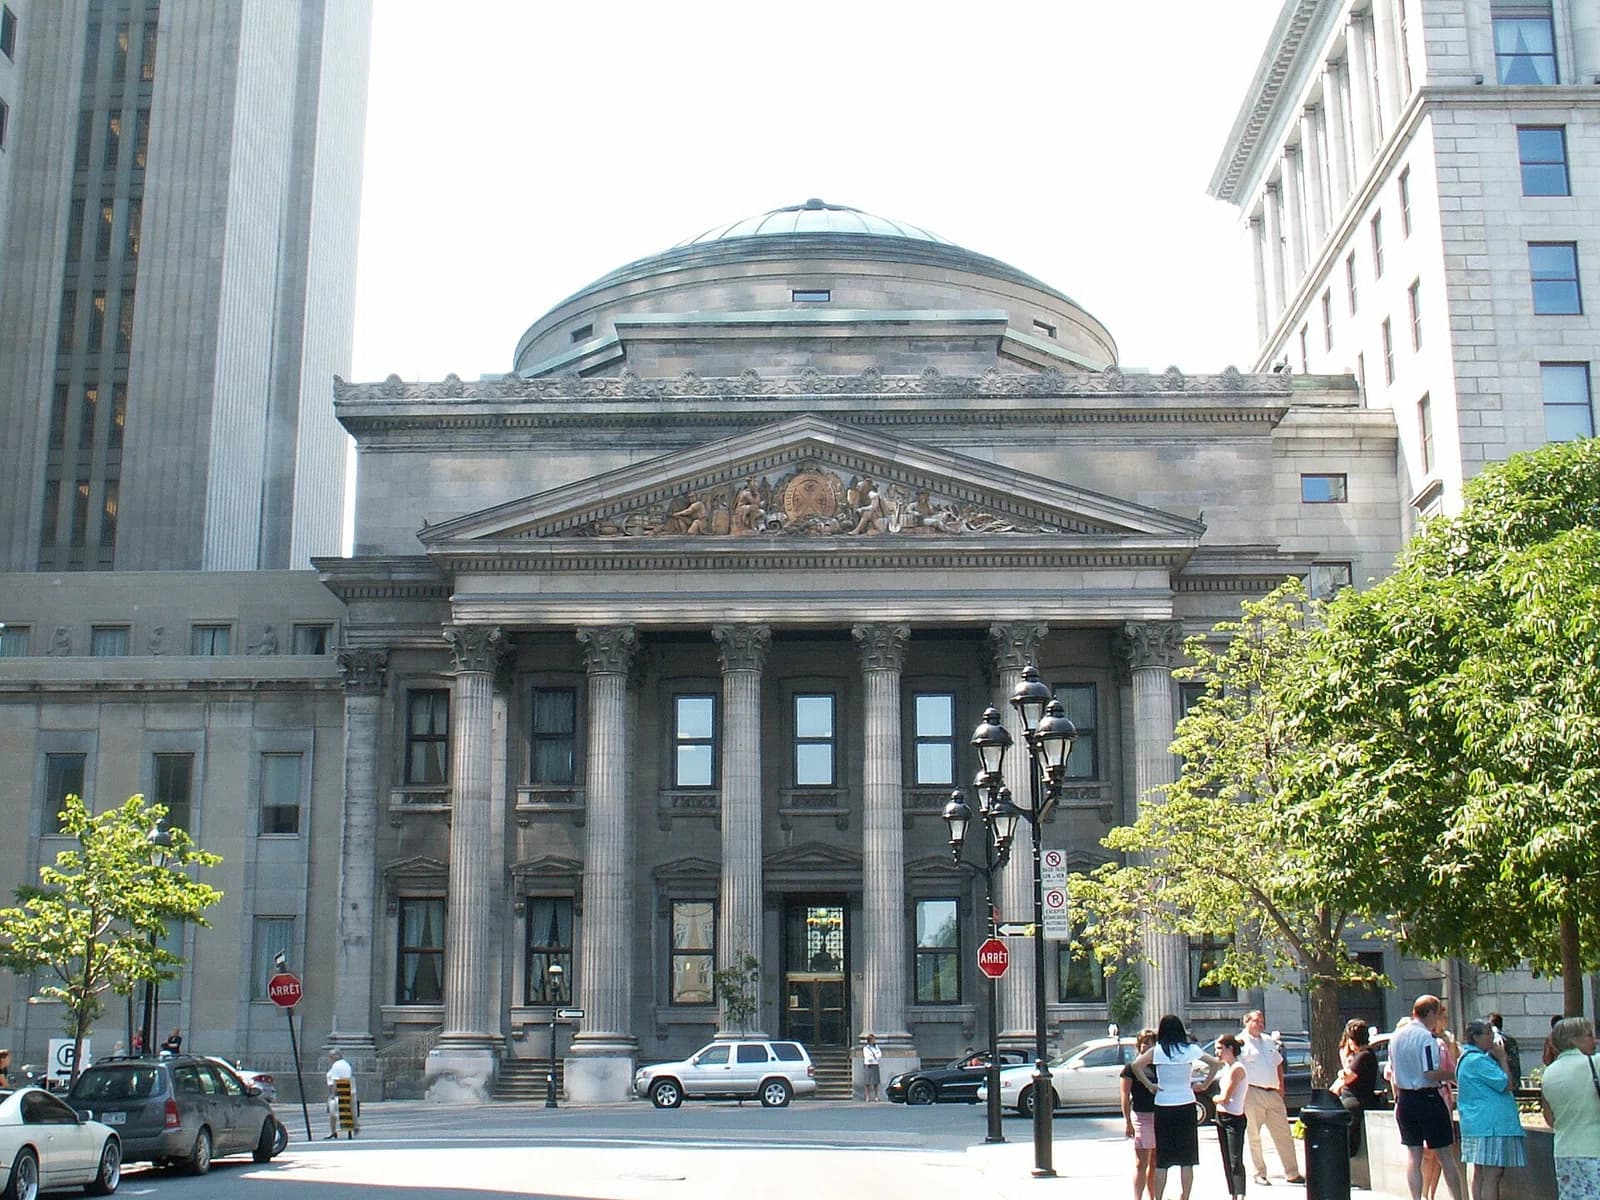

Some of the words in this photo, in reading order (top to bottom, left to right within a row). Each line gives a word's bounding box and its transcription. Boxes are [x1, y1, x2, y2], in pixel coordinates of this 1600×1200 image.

[981, 951, 1007, 964] ARRÊT
[271, 982, 300, 997] ARRÊT
[64, 1048, 75, 1064] P
